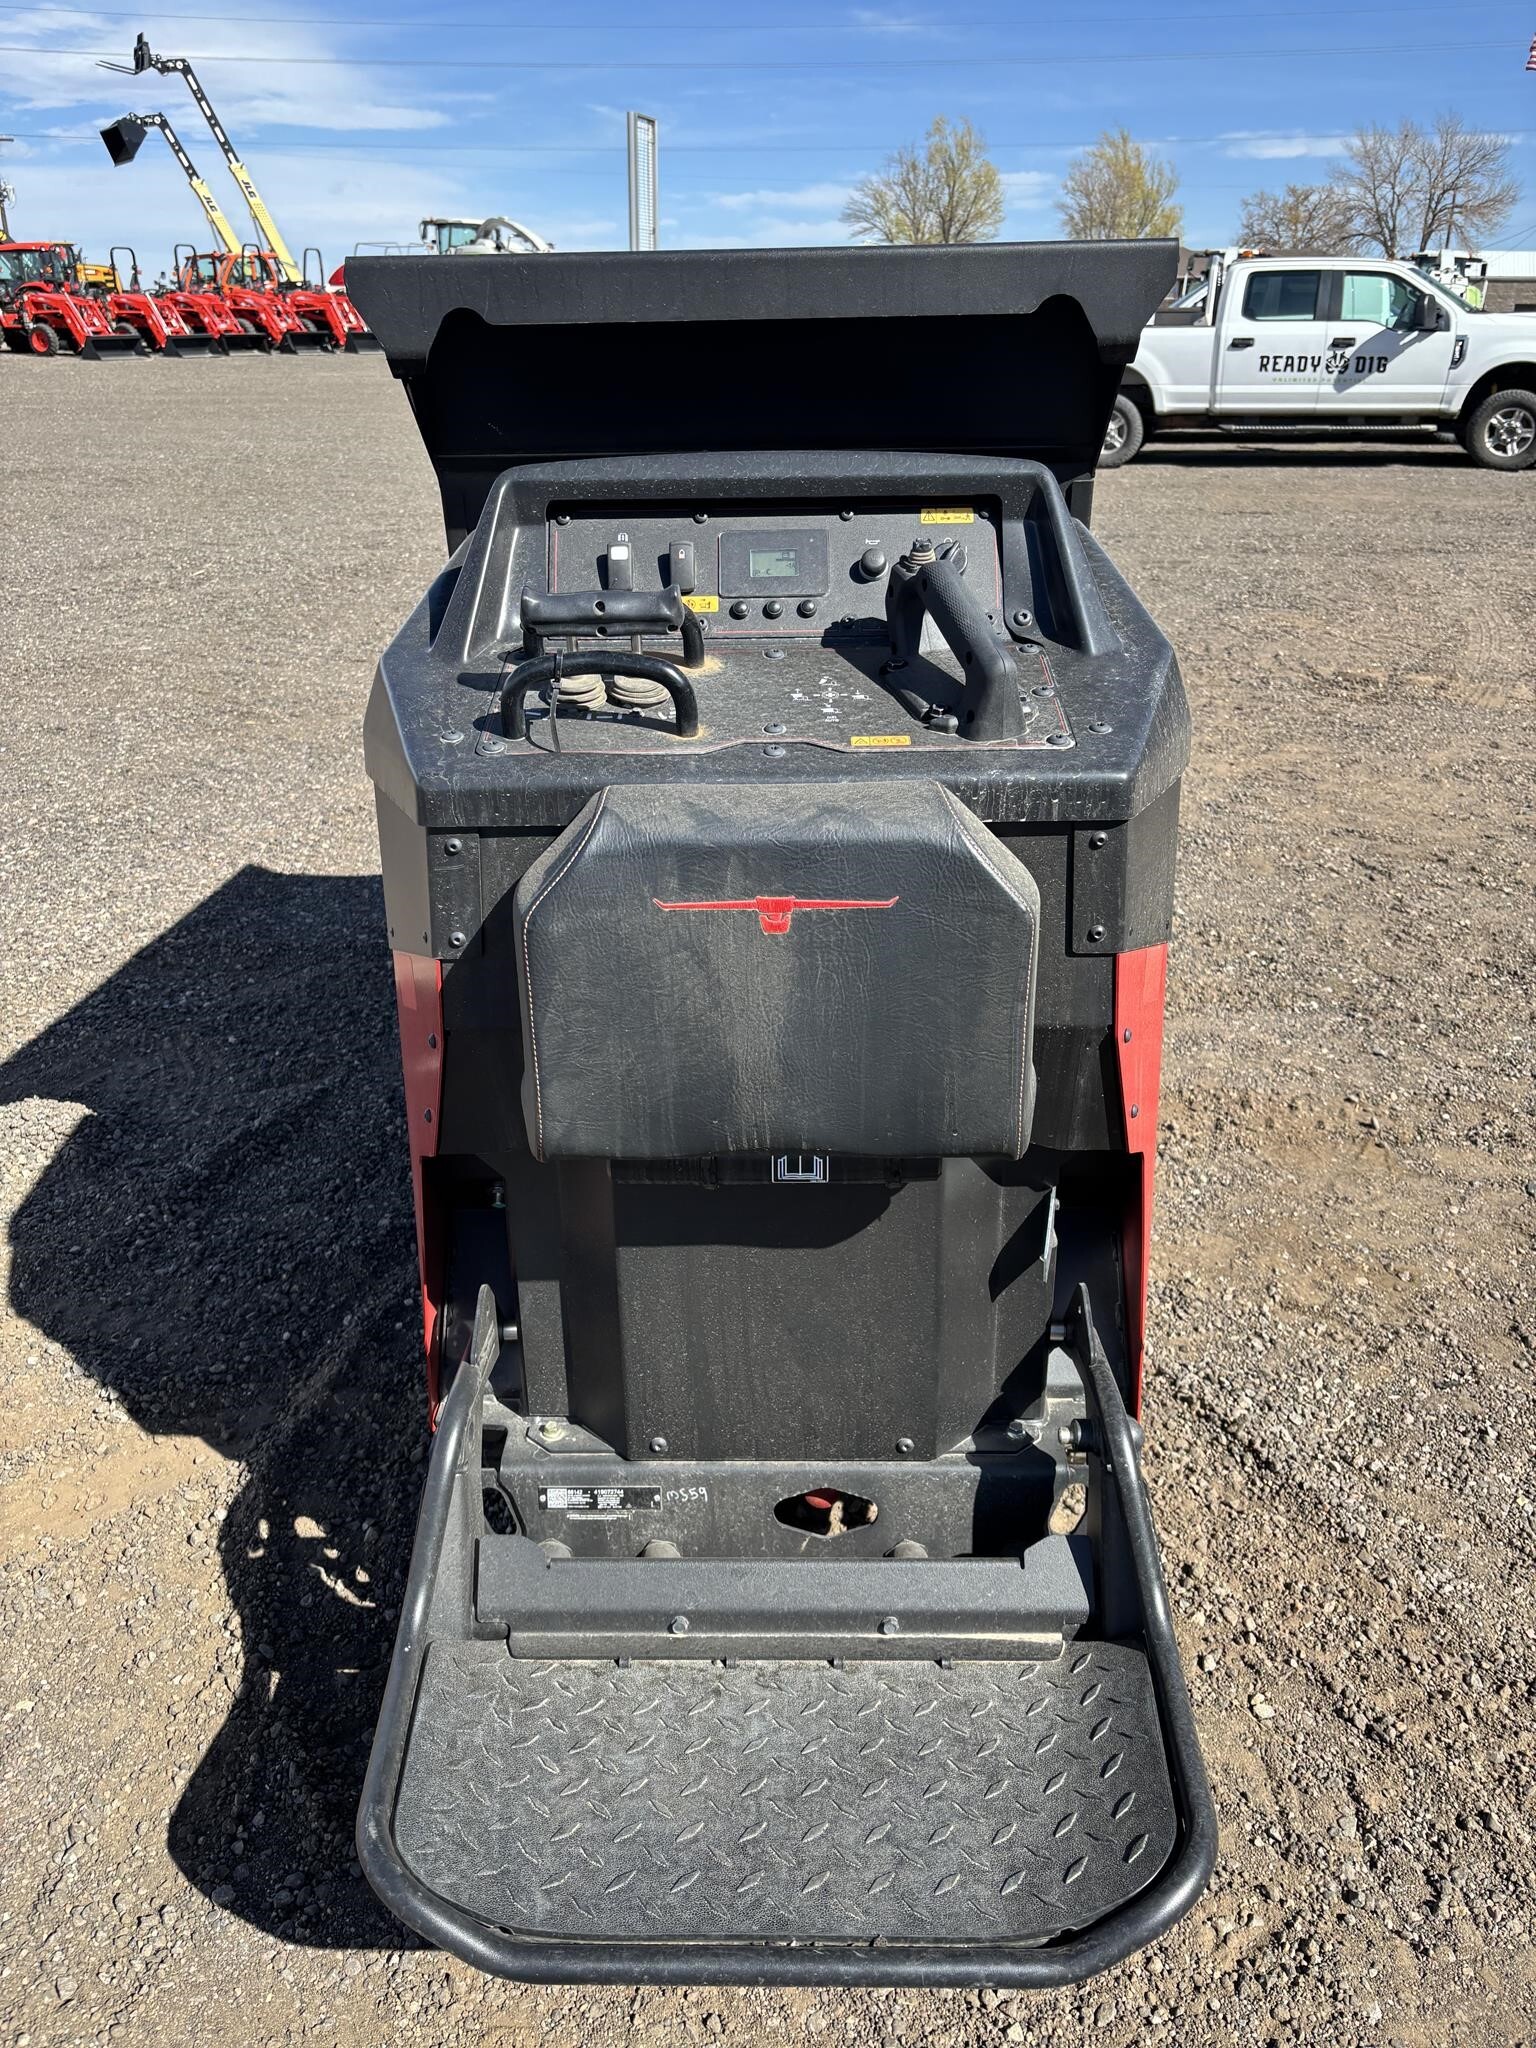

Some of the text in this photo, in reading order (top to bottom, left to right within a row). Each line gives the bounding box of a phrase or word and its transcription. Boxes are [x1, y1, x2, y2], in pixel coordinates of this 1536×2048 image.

[242, 180, 257, 198] JLG
[203, 195, 218, 212] JLG
[1259, 355, 1389, 373] READY DIG
